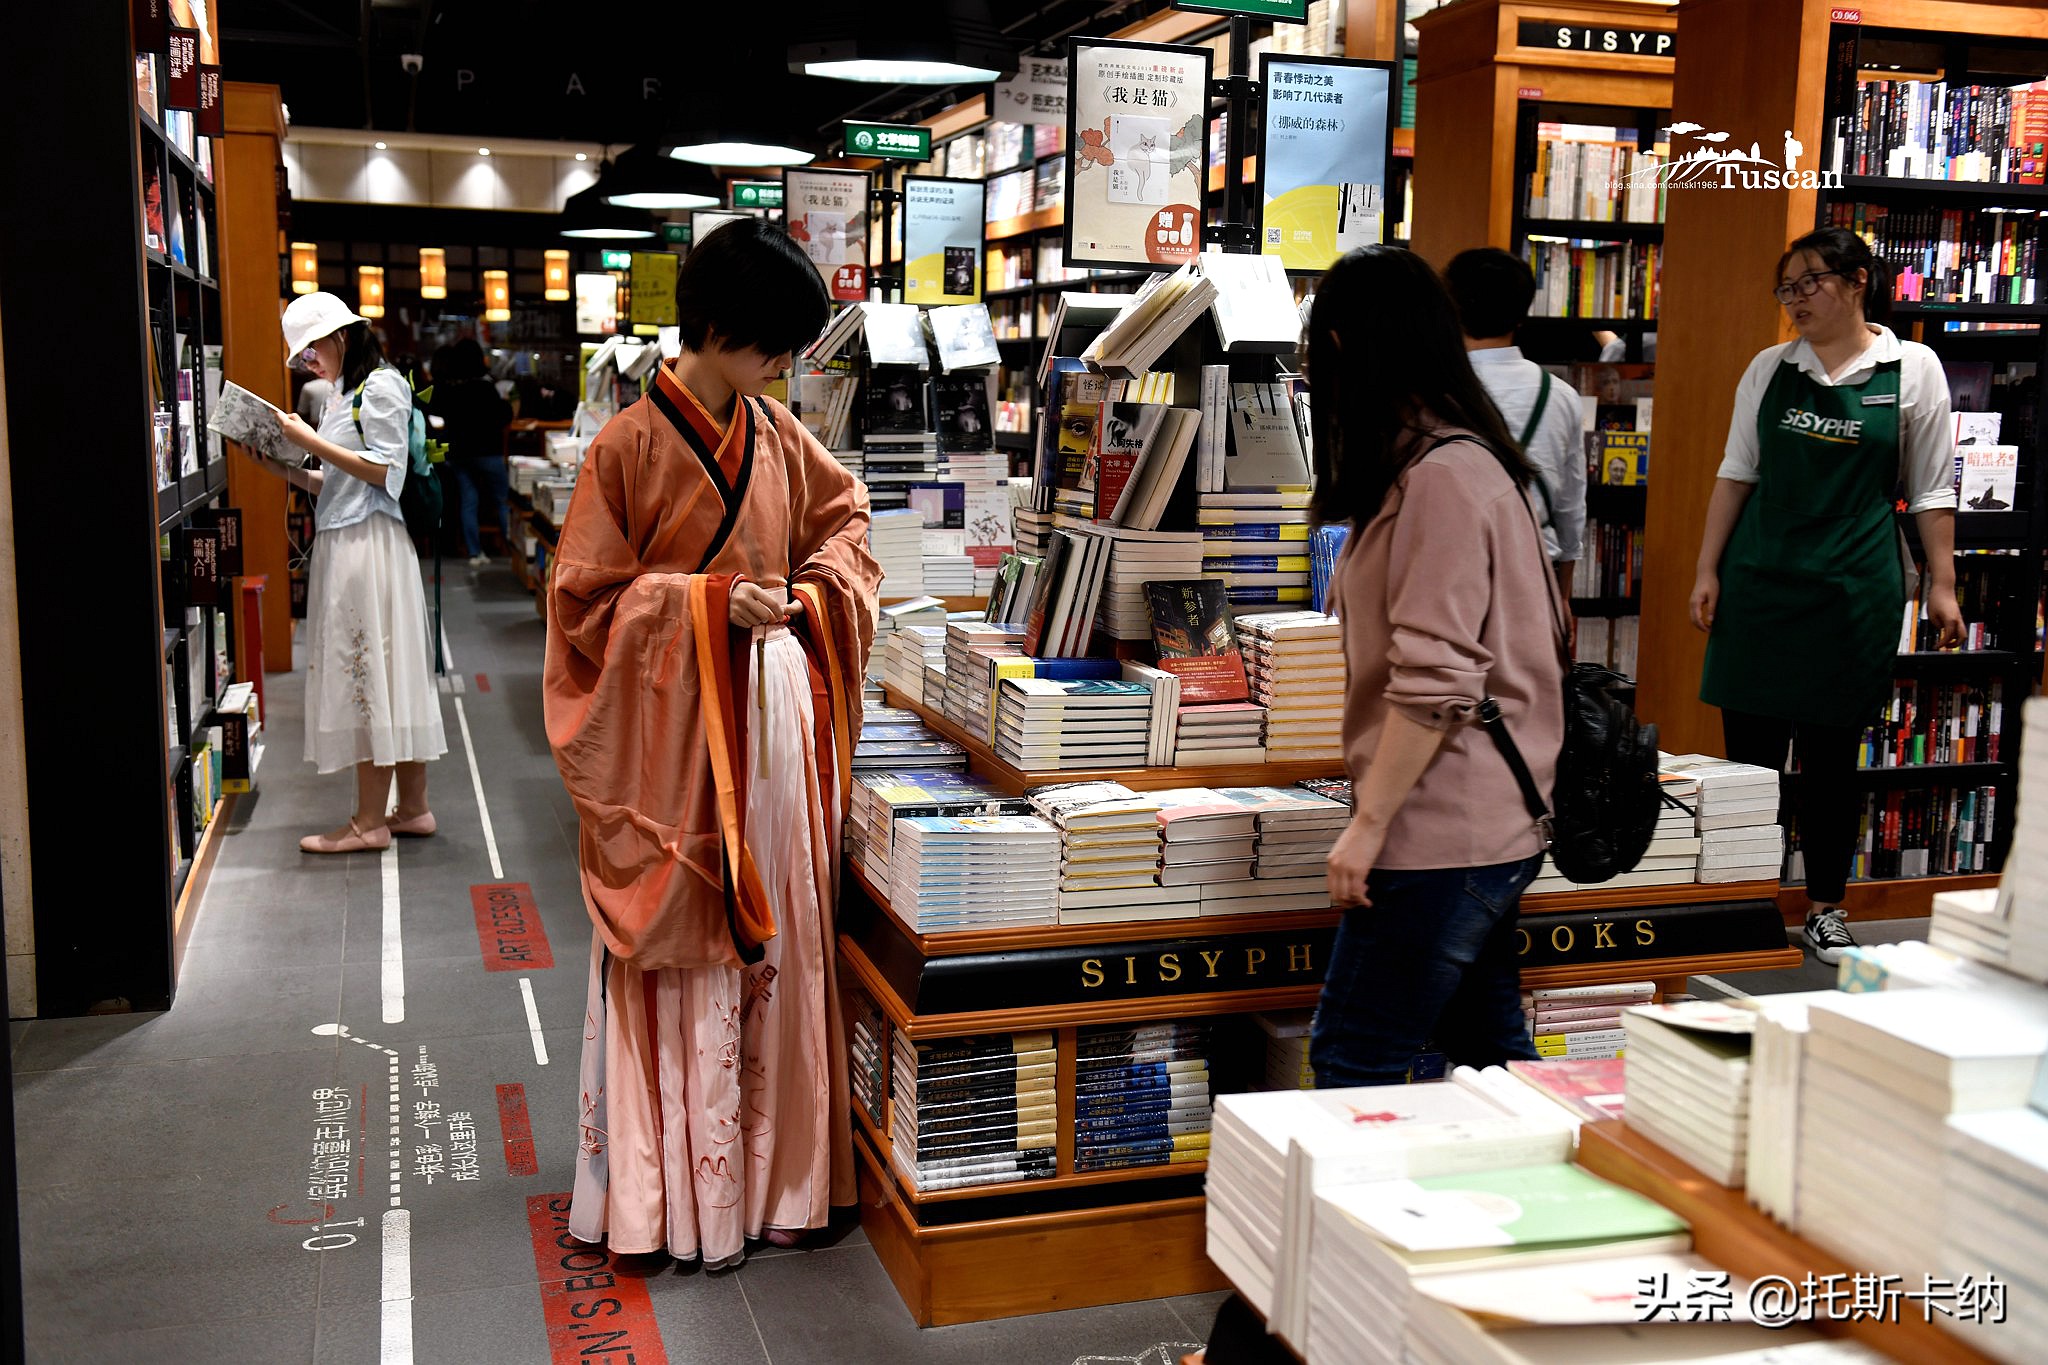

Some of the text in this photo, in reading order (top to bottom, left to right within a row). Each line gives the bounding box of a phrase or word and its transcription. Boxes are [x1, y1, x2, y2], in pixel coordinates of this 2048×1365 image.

[1557, 28, 1671, 54] SISYP
[1098, 70, 1184, 84] 原创手绘插图 定制珍藏版
[1273, 71, 1334, 87] 青春悸动之美
[1103, 85, 1178, 108] 《我是猫》
[1272, 89, 1344, 104] 影响了几代读者
[1158, 211, 1174, 229] 赠
[1108, 438, 1144, 449] 人间失格
[1607, 436, 1647, 446] IKEA
[1967, 451, 2007, 467] 暗黑者
[193, 537, 205, 577] 绘画入门
[1182, 586, 1199, 626] 新参者
[1515, 919, 1656, 955] OOKS
[496, 938, 535, 962] ART
[1081, 944, 1313, 988] SISYPH
[412, 1100, 442, 1139] 一个数字
[307, 1087, 351, 1200] 缤纷的童年小世界
[446, 1111, 481, 1181] 成长从这里开始
[413, 1143, 445, 1185] 一抹色彩
